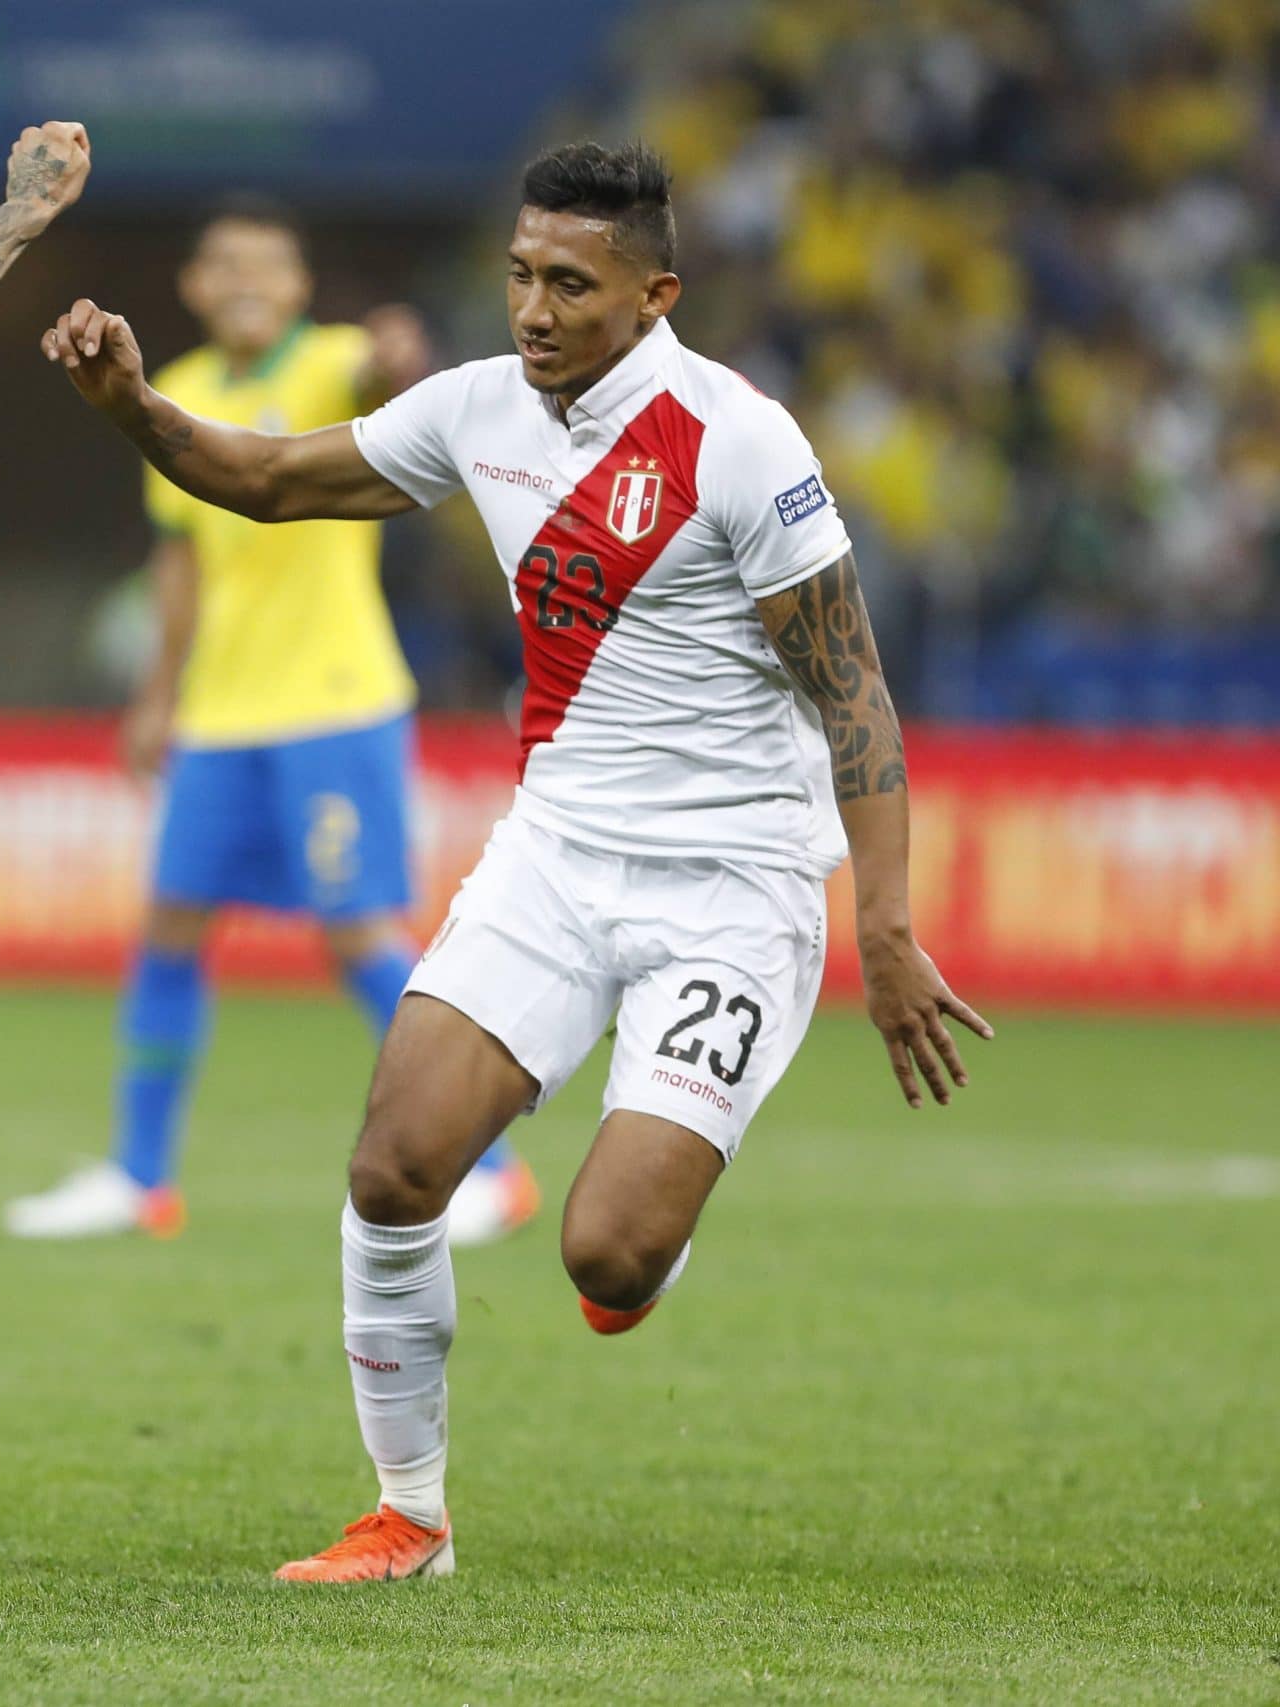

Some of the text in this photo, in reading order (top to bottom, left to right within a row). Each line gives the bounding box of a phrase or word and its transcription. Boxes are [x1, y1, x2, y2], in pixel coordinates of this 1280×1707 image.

[472, 461, 553, 491] marathon
[778, 480, 819, 509] Cree en
[782, 491, 822, 524] grande
[521, 544, 619, 631] 23
[656, 979, 762, 1086] 23
[650, 1067, 733, 1116] marathon
